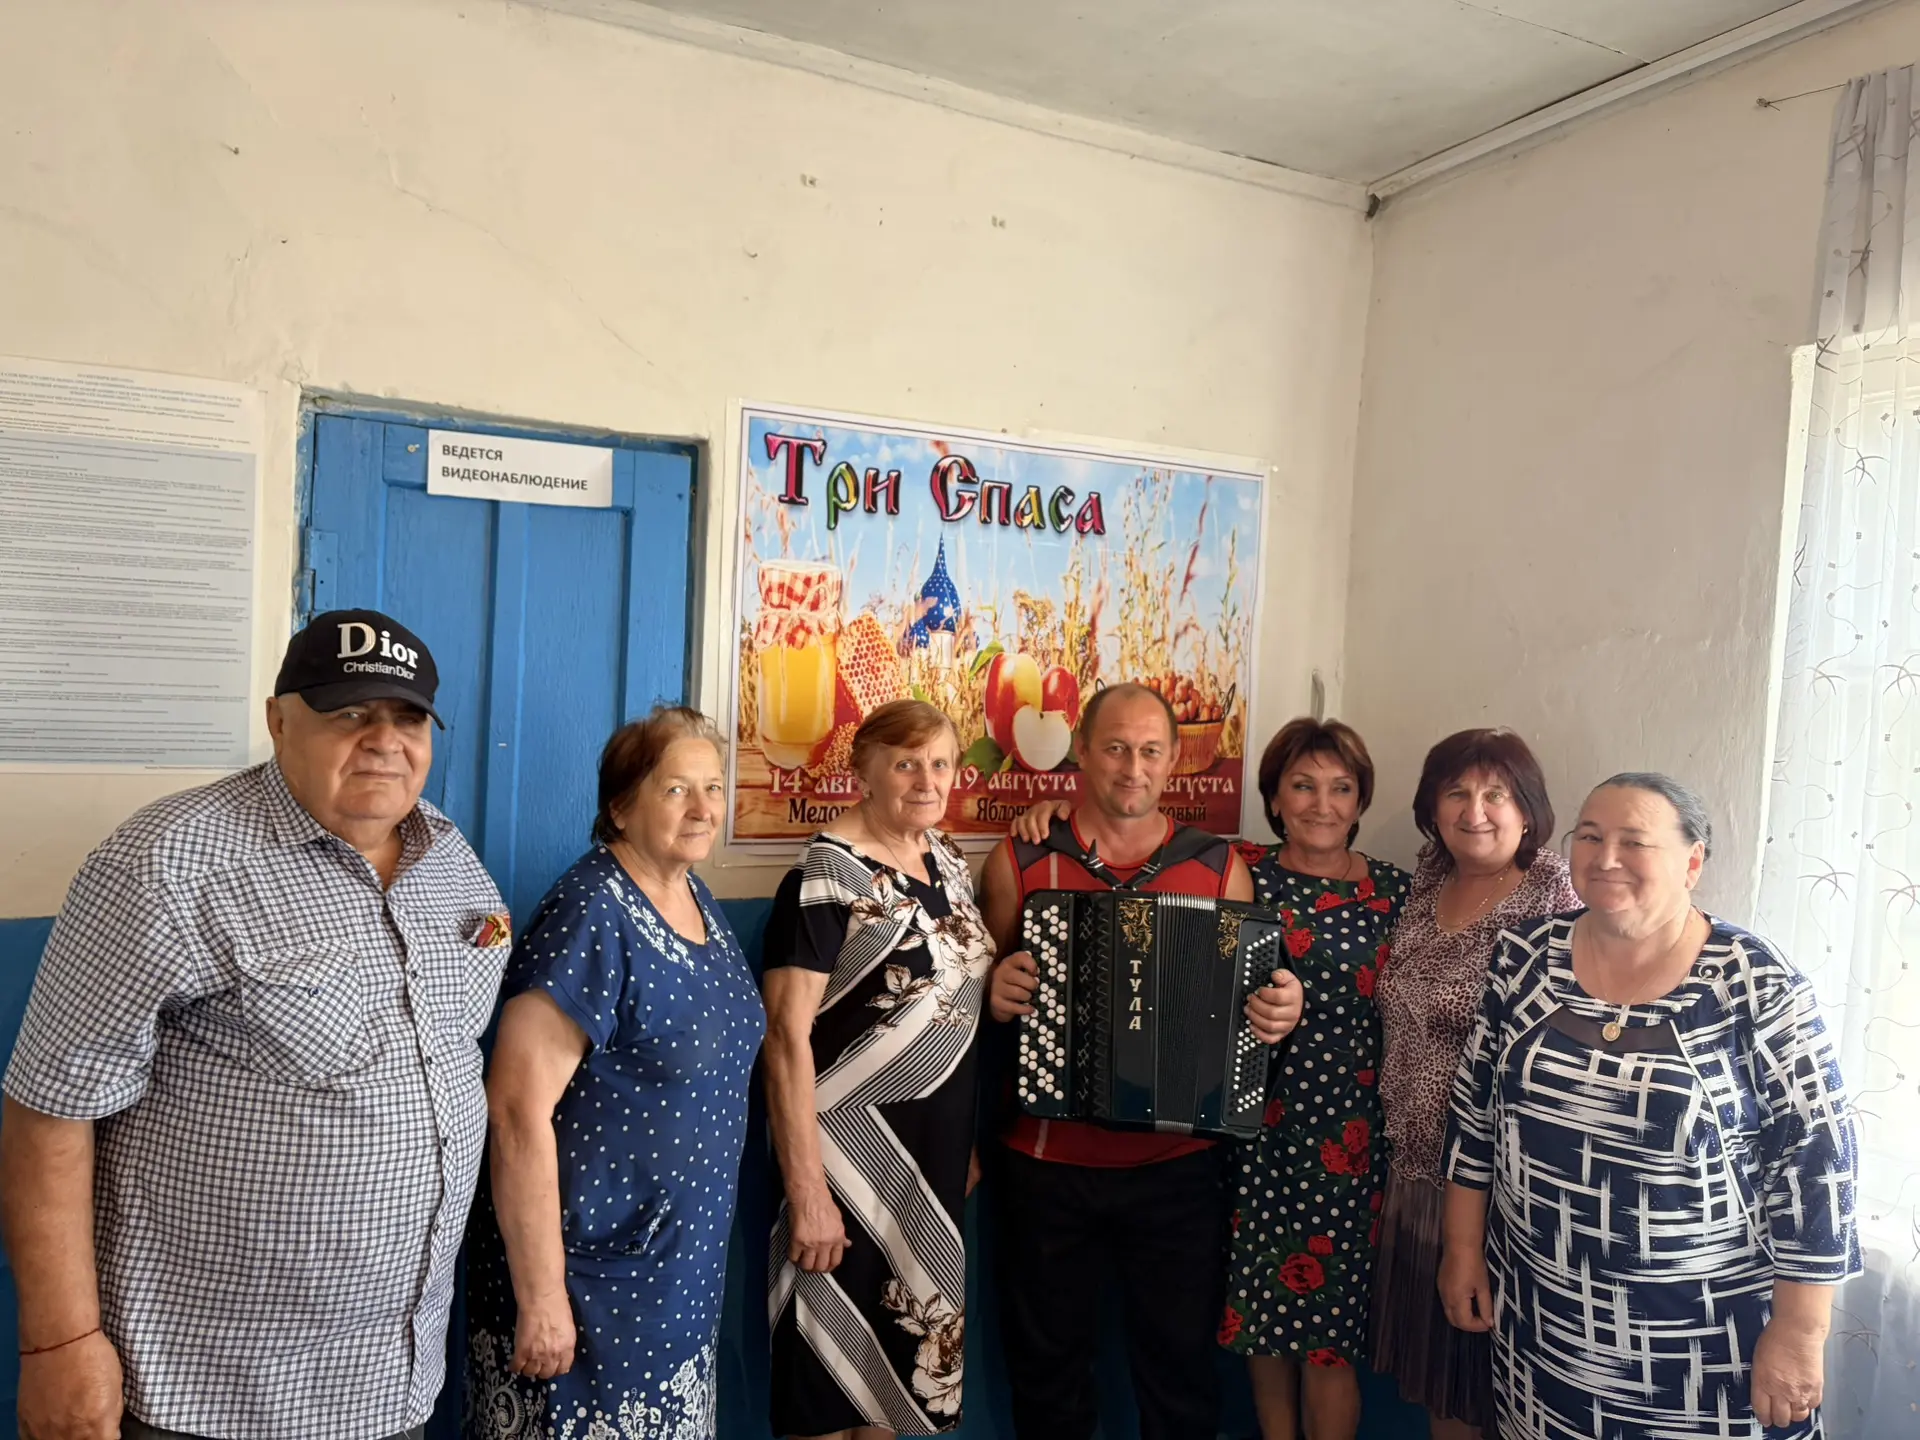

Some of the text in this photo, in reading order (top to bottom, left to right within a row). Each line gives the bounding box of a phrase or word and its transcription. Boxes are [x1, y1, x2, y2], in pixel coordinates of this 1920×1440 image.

[442, 444, 503, 461] ВЕДЕТСЯ
[441, 466, 588, 491] ВИДЕОНАБЛЮДЕНИЕ
[765, 432, 1106, 535] Три Спаса
[337, 622, 418, 669] Dior
[770, 768, 858, 794] 14 авг
[952, 765, 1077, 799] 19 августа
[1162, 776, 1234, 800] вгуста
[788, 797, 850, 824] Медо
[977, 797, 1030, 822] Яблоч
[1158, 802, 1207, 821] овый
[1128, 959, 1142, 1031] ТУЛА
